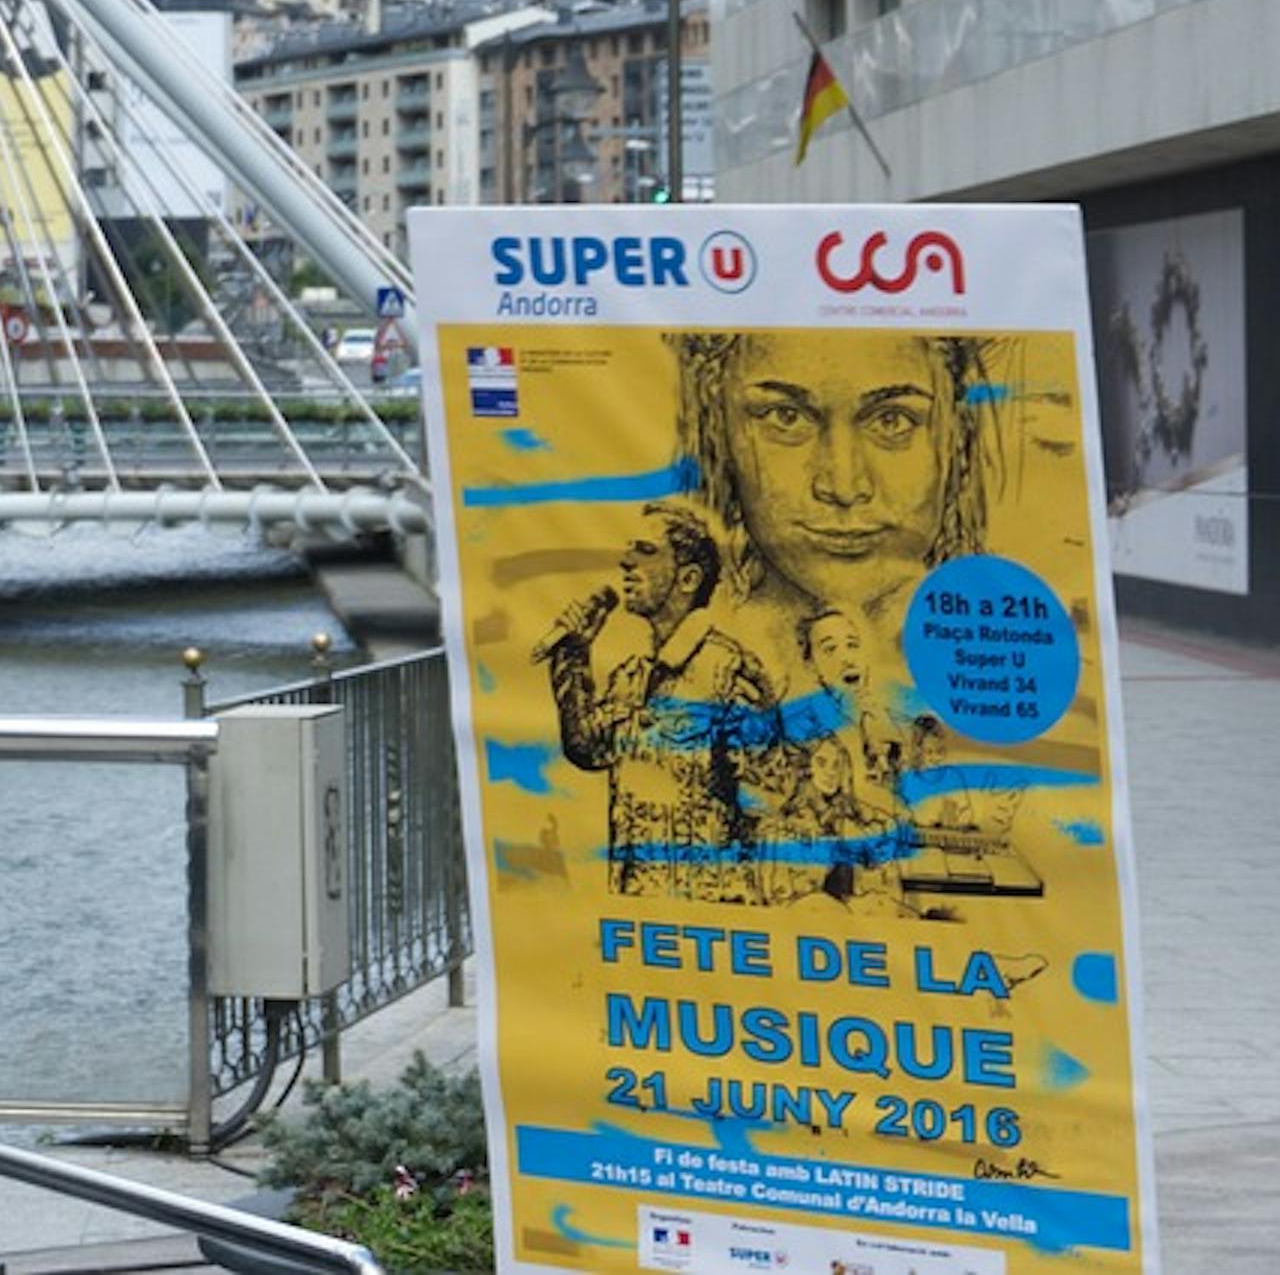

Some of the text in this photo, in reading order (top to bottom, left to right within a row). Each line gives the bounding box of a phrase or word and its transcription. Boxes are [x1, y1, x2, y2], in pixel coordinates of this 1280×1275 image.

[491, 236, 689, 286] SUPER
[497, 291, 598, 316] Andorra
[925, 592, 1049, 619] 18h a 21h
[924, 622, 1054, 645] Plaça Rotonda
[955, 649, 1025, 669] Super U
[948, 674, 1037, 694] Vivand 34
[950, 699, 1038, 718] Vivand 65
[598, 917, 1011, 1000] FETE DE LA
[604, 992, 1016, 1089] MUSIQUE
[604, 1067, 1023, 1149] 21 JUNY 2016
[654, 1148, 965, 1201] Fi de festa amb LATIN STRIDE
[591, 1162, 1037, 1235] 21h15 al Teatre Comunal d'Andorra la Vella
